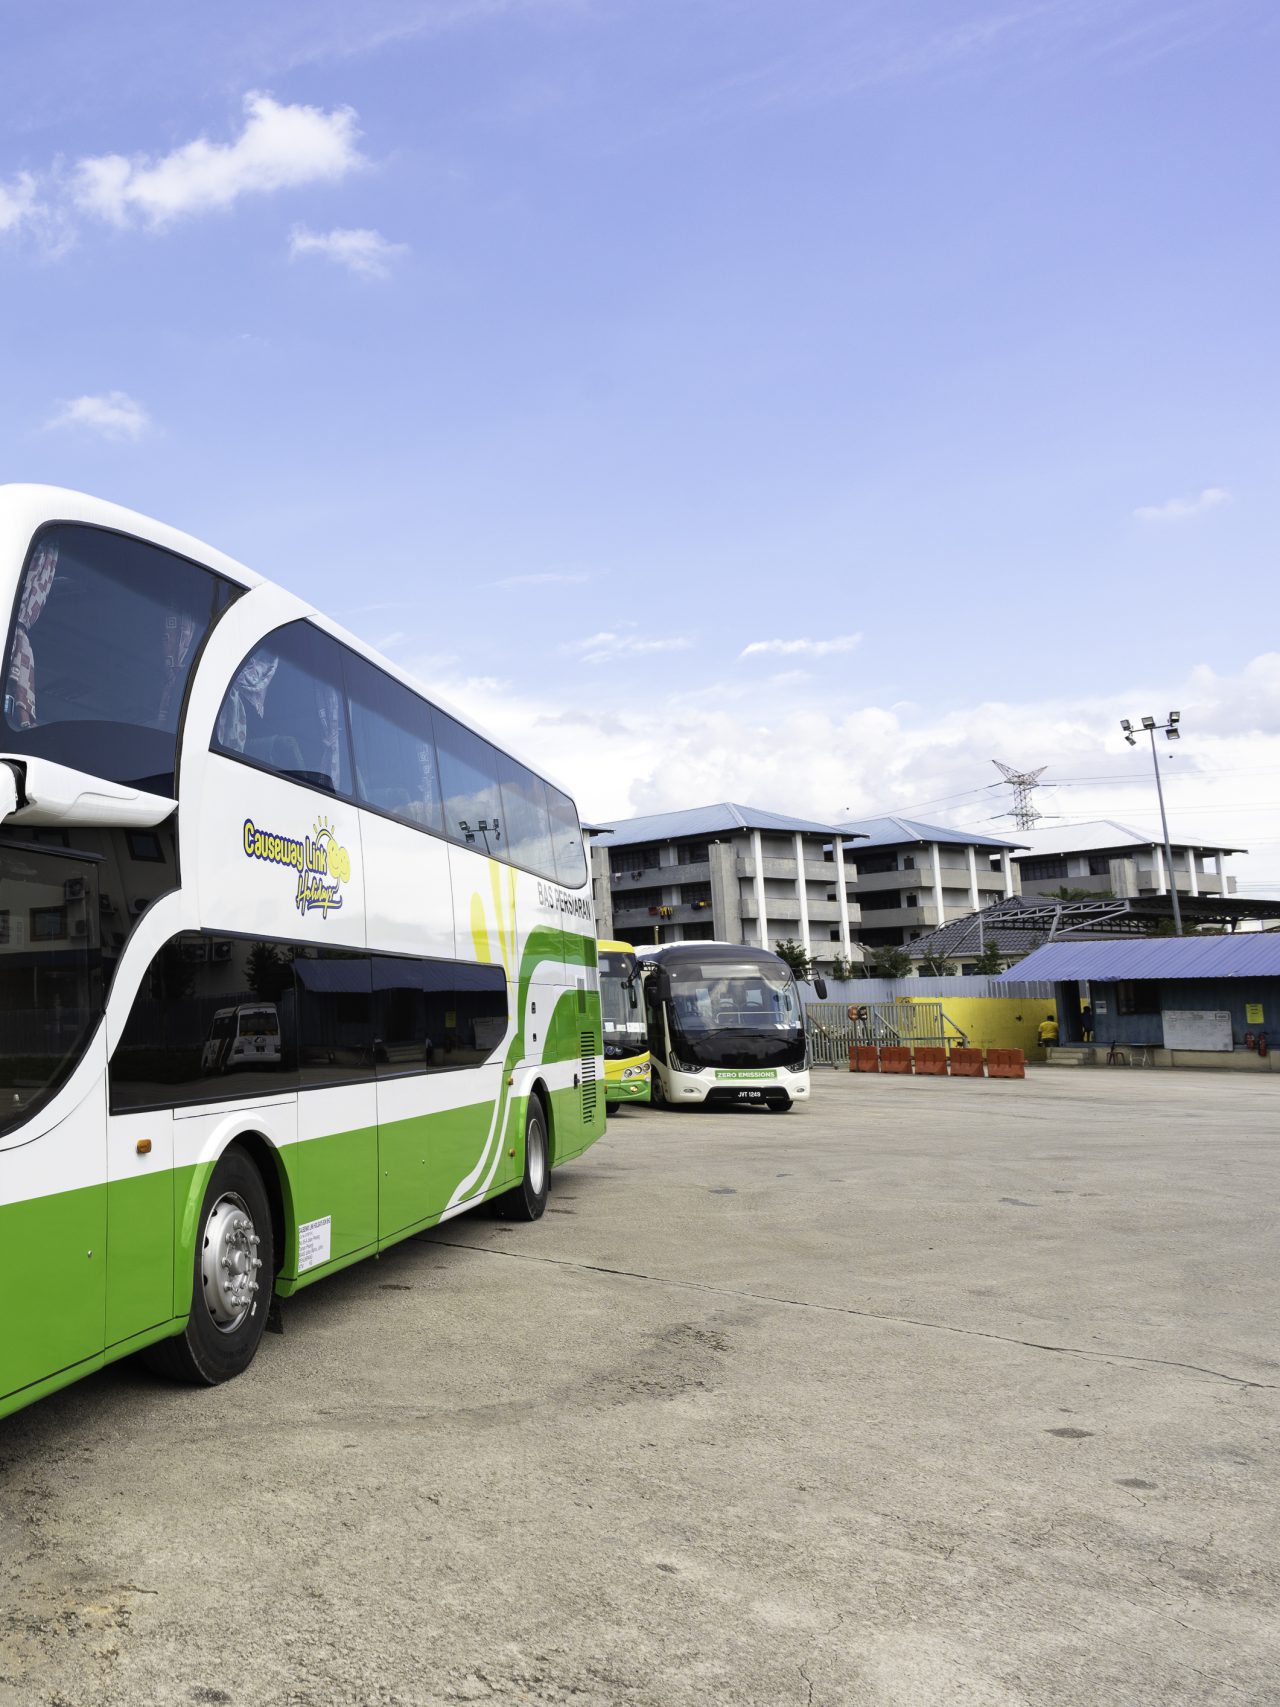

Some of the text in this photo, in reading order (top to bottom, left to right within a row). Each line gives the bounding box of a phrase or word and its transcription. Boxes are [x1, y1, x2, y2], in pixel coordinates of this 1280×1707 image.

[244, 818, 327, 876] Causeway Link
[296, 869, 342, 920] Holidays
[537, 881, 591, 921] BAS PERSIARAN
